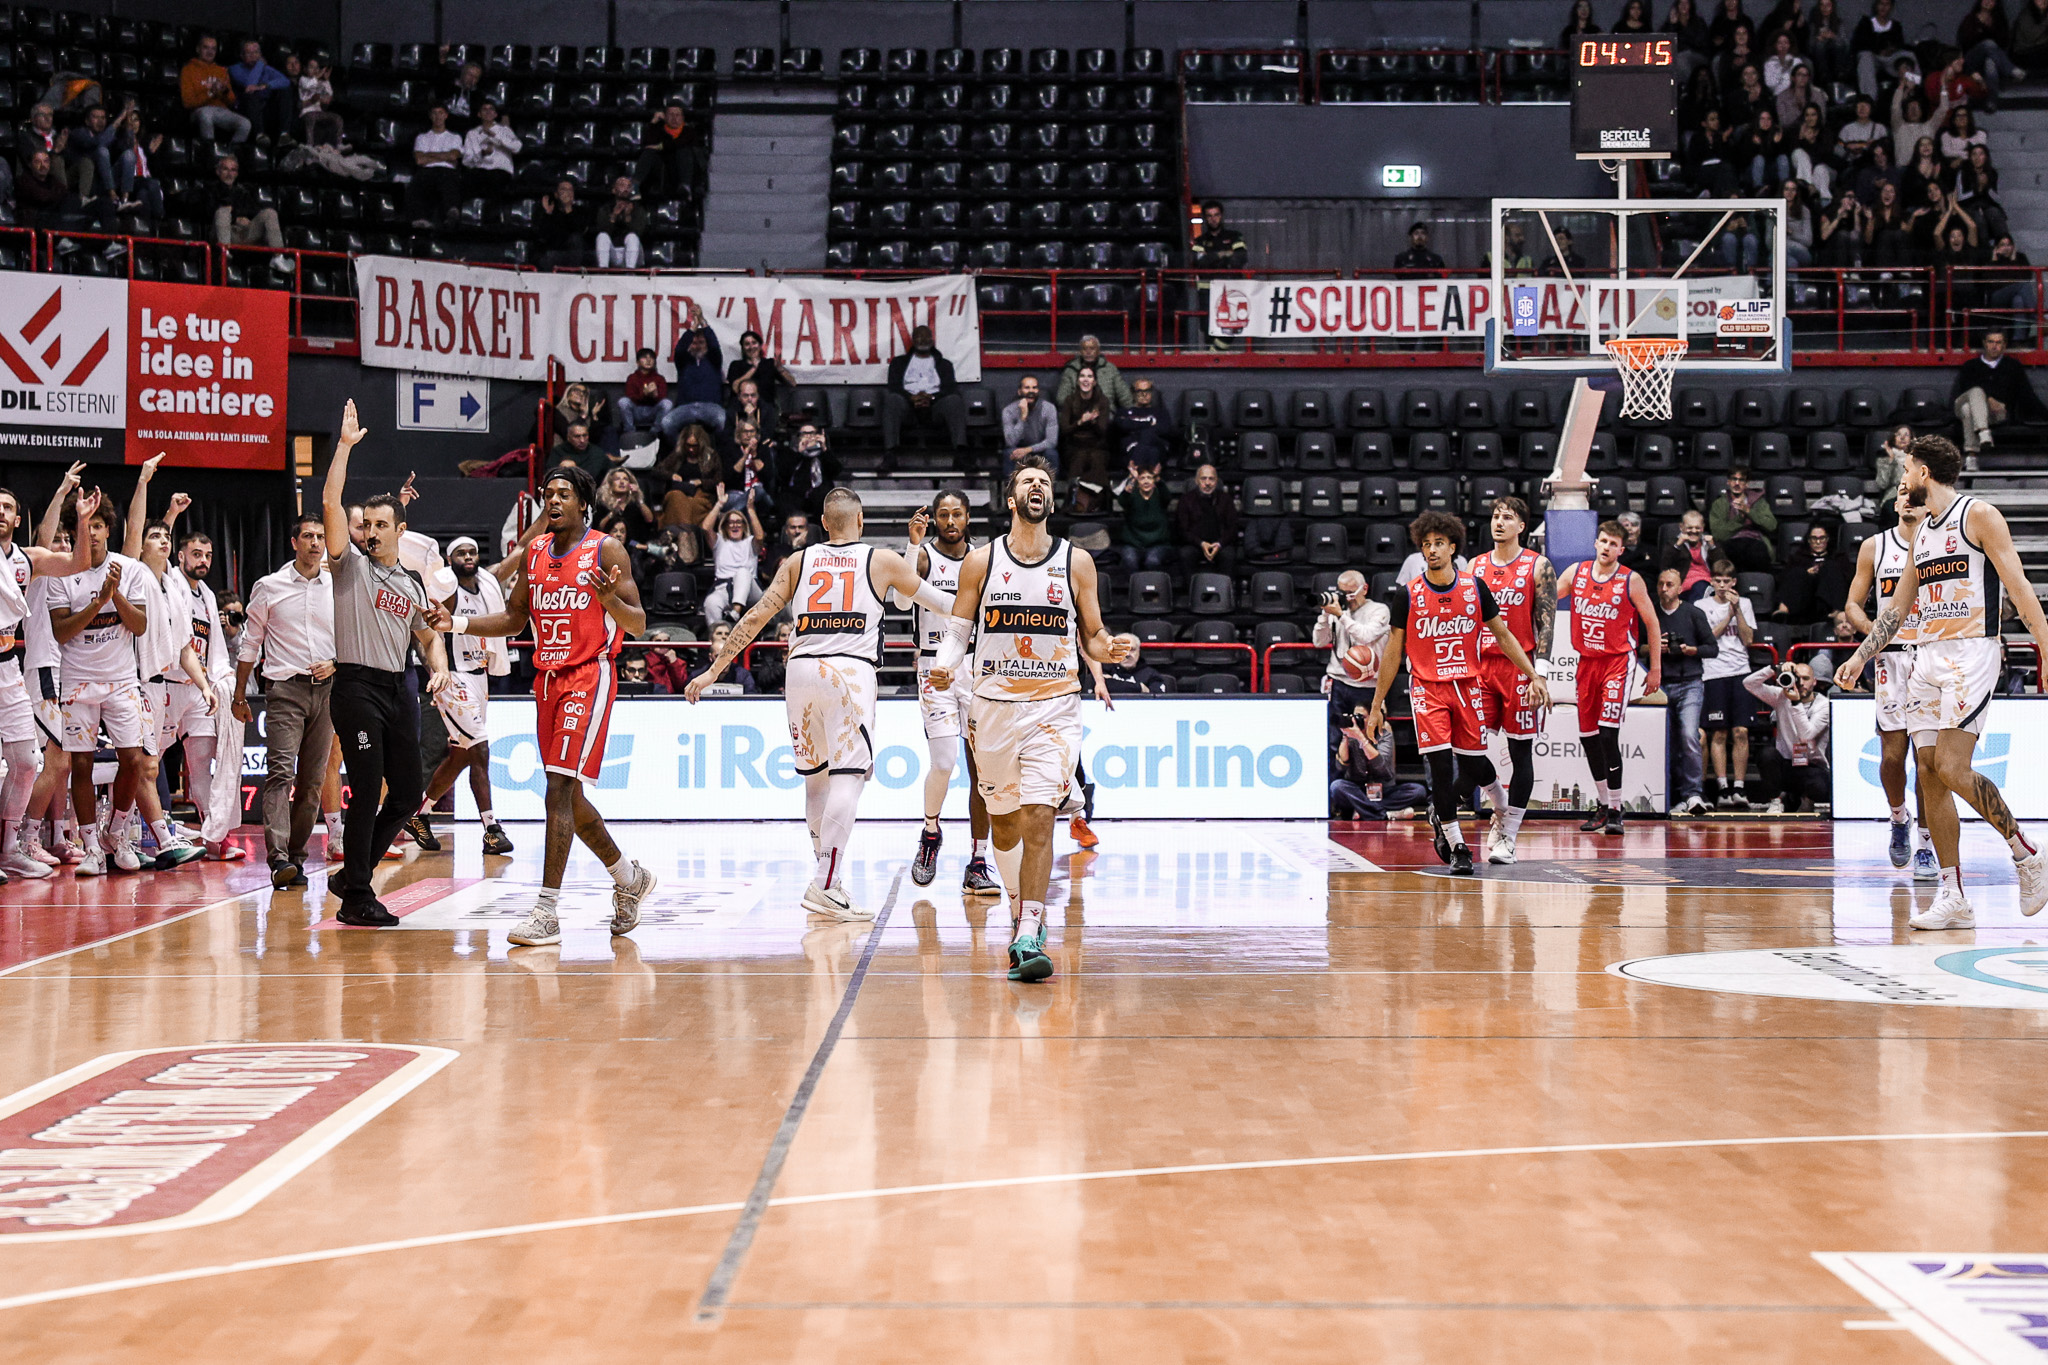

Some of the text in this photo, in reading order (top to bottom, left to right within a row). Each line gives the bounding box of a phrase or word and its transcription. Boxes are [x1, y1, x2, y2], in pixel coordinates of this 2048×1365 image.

[1580, 40, 1672, 66] 04:15
[141, 307, 242, 344] Le tue
[375, 275, 540, 361] BASKET
[1515, 318, 1537, 327] FIP
[140, 341, 253, 380] idee in
[46, 391, 116, 415] ESTERNI
[139, 381, 274, 418] cantiere
[413, 382, 437, 424] F
[137, 429, 154, 439] UNA
[154, 430, 173, 440] SOLA
[173, 430, 205, 441] AZIENDA
[205, 432, 219, 442] PER
[220, 432, 240, 443] TANTI
[812, 556, 858, 569] ARADORI
[1919, 560, 1968, 580] unieuro
[807, 570, 856, 613] 21
[932, 579, 956, 587] IGNIS
[381, 591, 408, 609] ATTAL
[529, 583, 592, 611] Mestre
[990, 592, 1022, 602] IGNIS
[1491, 586, 1525, 607] stre
[1573, 595, 1620, 620] Mestre
[810, 615, 865, 629] unieuro
[1003, 609, 1067, 629] unieuro
[1415, 614, 1477, 640] Mestre
[1019, 635, 1033, 658] 8
[997, 669, 1066, 679] ASSICURAZIONI
[998, 659, 1067, 672] ITALIANA
[1436, 665, 1468, 676] GEMINI
[1515, 710, 1534, 730] 45
[1601, 701, 1621, 720] 35
[559, 735, 571, 761] 1
[677, 723, 706, 789] il
[720, 724, 920, 790] Reo
[1082, 719, 1304, 790] arlino
